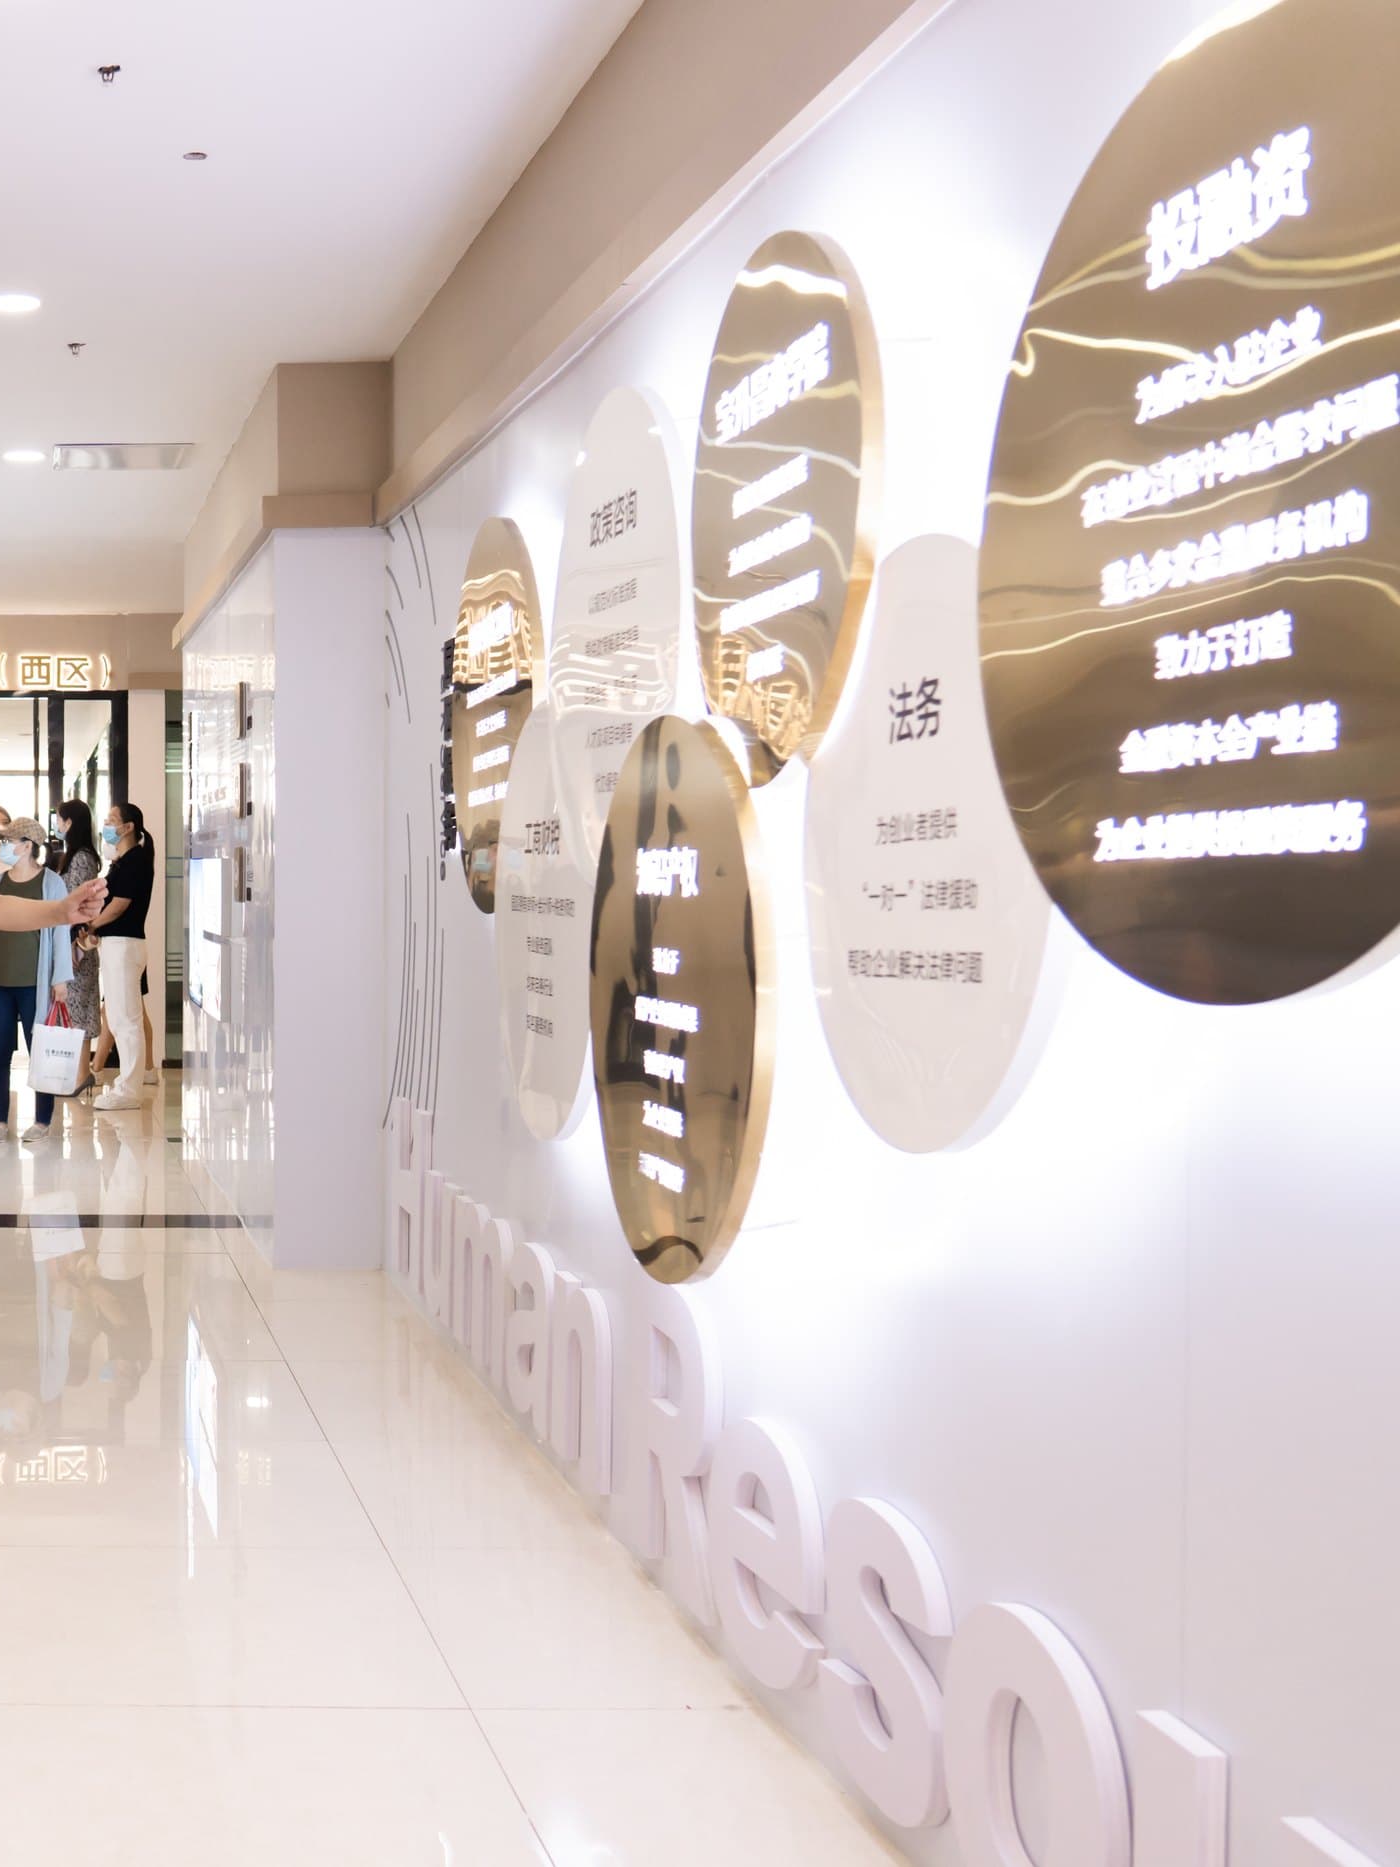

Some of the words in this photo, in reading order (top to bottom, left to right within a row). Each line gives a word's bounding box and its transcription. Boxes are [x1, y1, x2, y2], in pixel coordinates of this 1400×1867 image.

[590, 489, 637, 548] 政策咨询
[889, 676, 942, 744] 法务
[875, 808, 958, 845] 为创业者提供
[388, 1095, 612, 1496] Human
